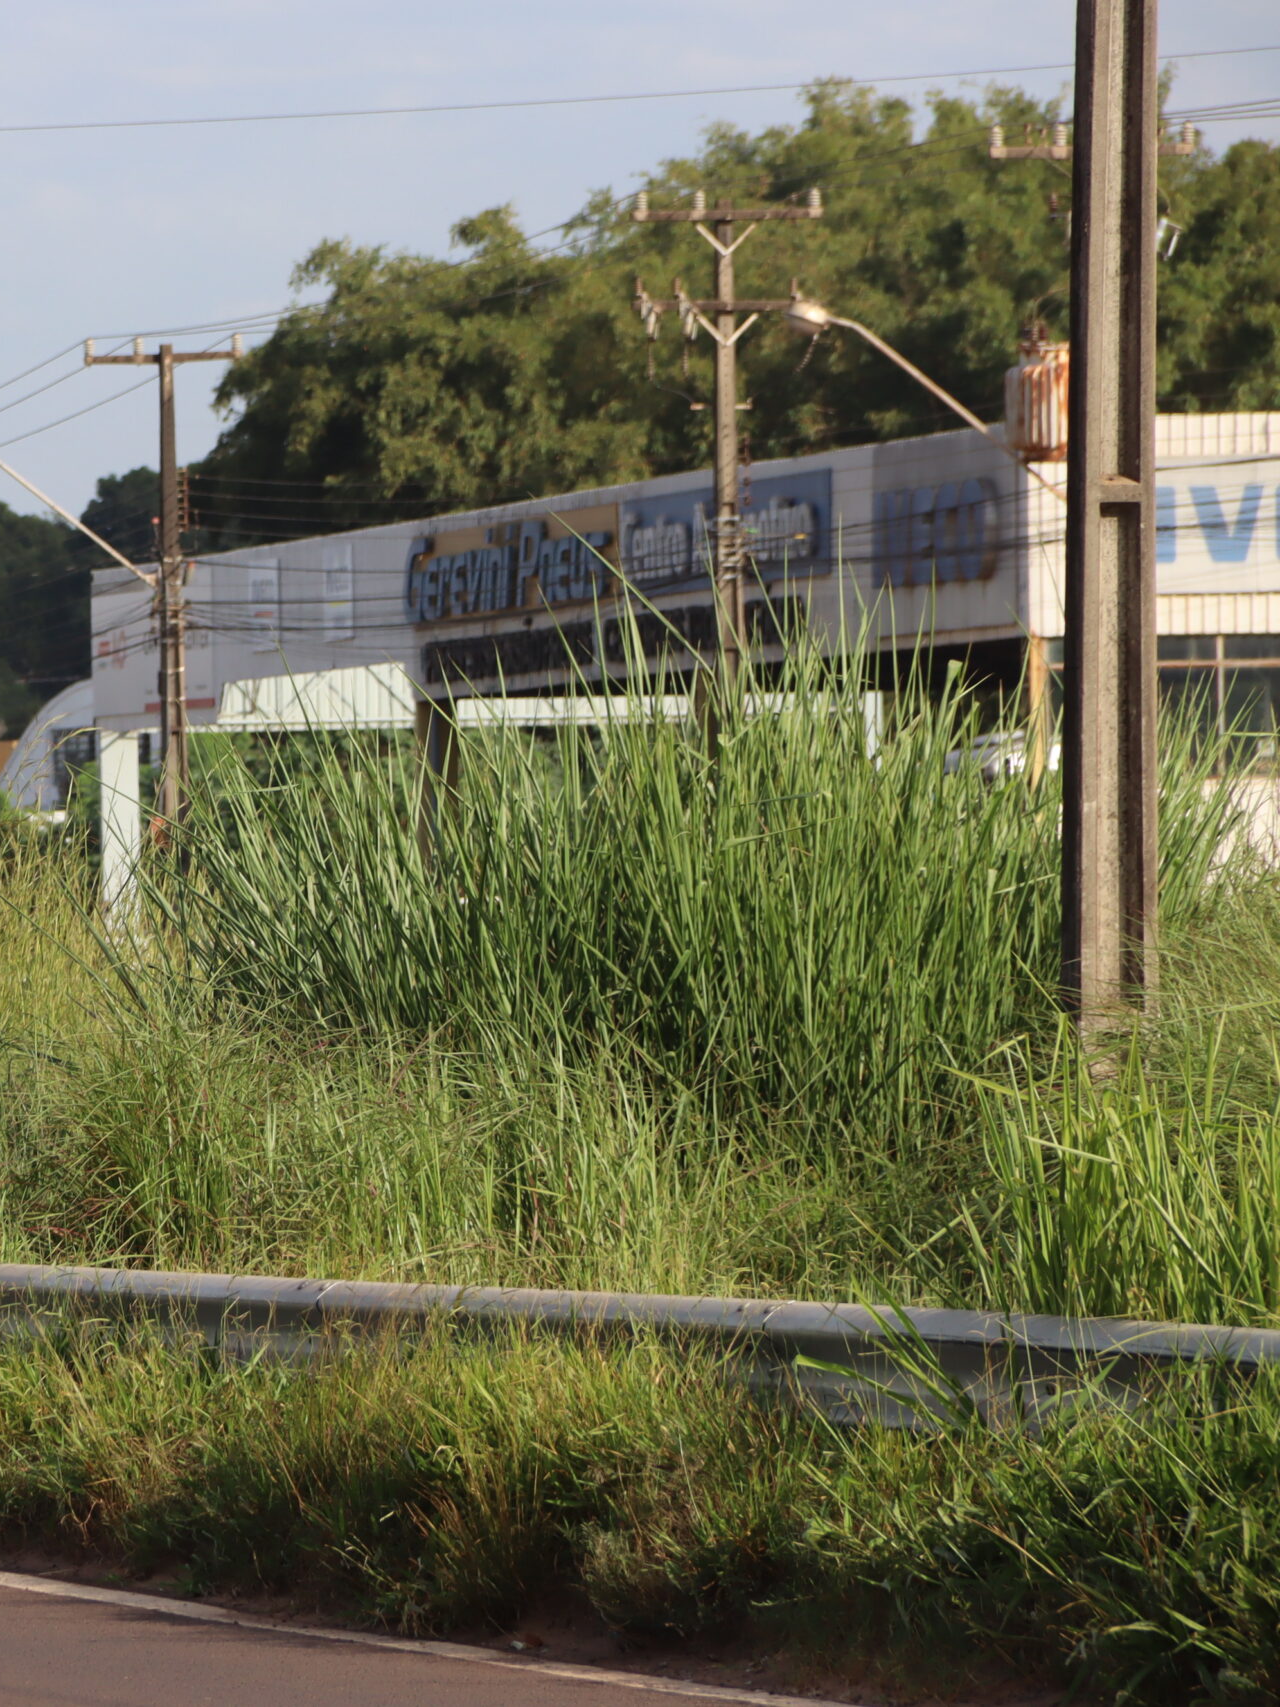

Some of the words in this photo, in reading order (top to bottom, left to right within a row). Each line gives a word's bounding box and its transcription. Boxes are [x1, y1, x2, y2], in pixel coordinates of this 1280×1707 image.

[403, 524, 515, 622] Gerevini
[516, 520, 610, 608] Pneus
[873, 479, 992, 589] IVECO
[1156, 484, 1280, 564] IV
